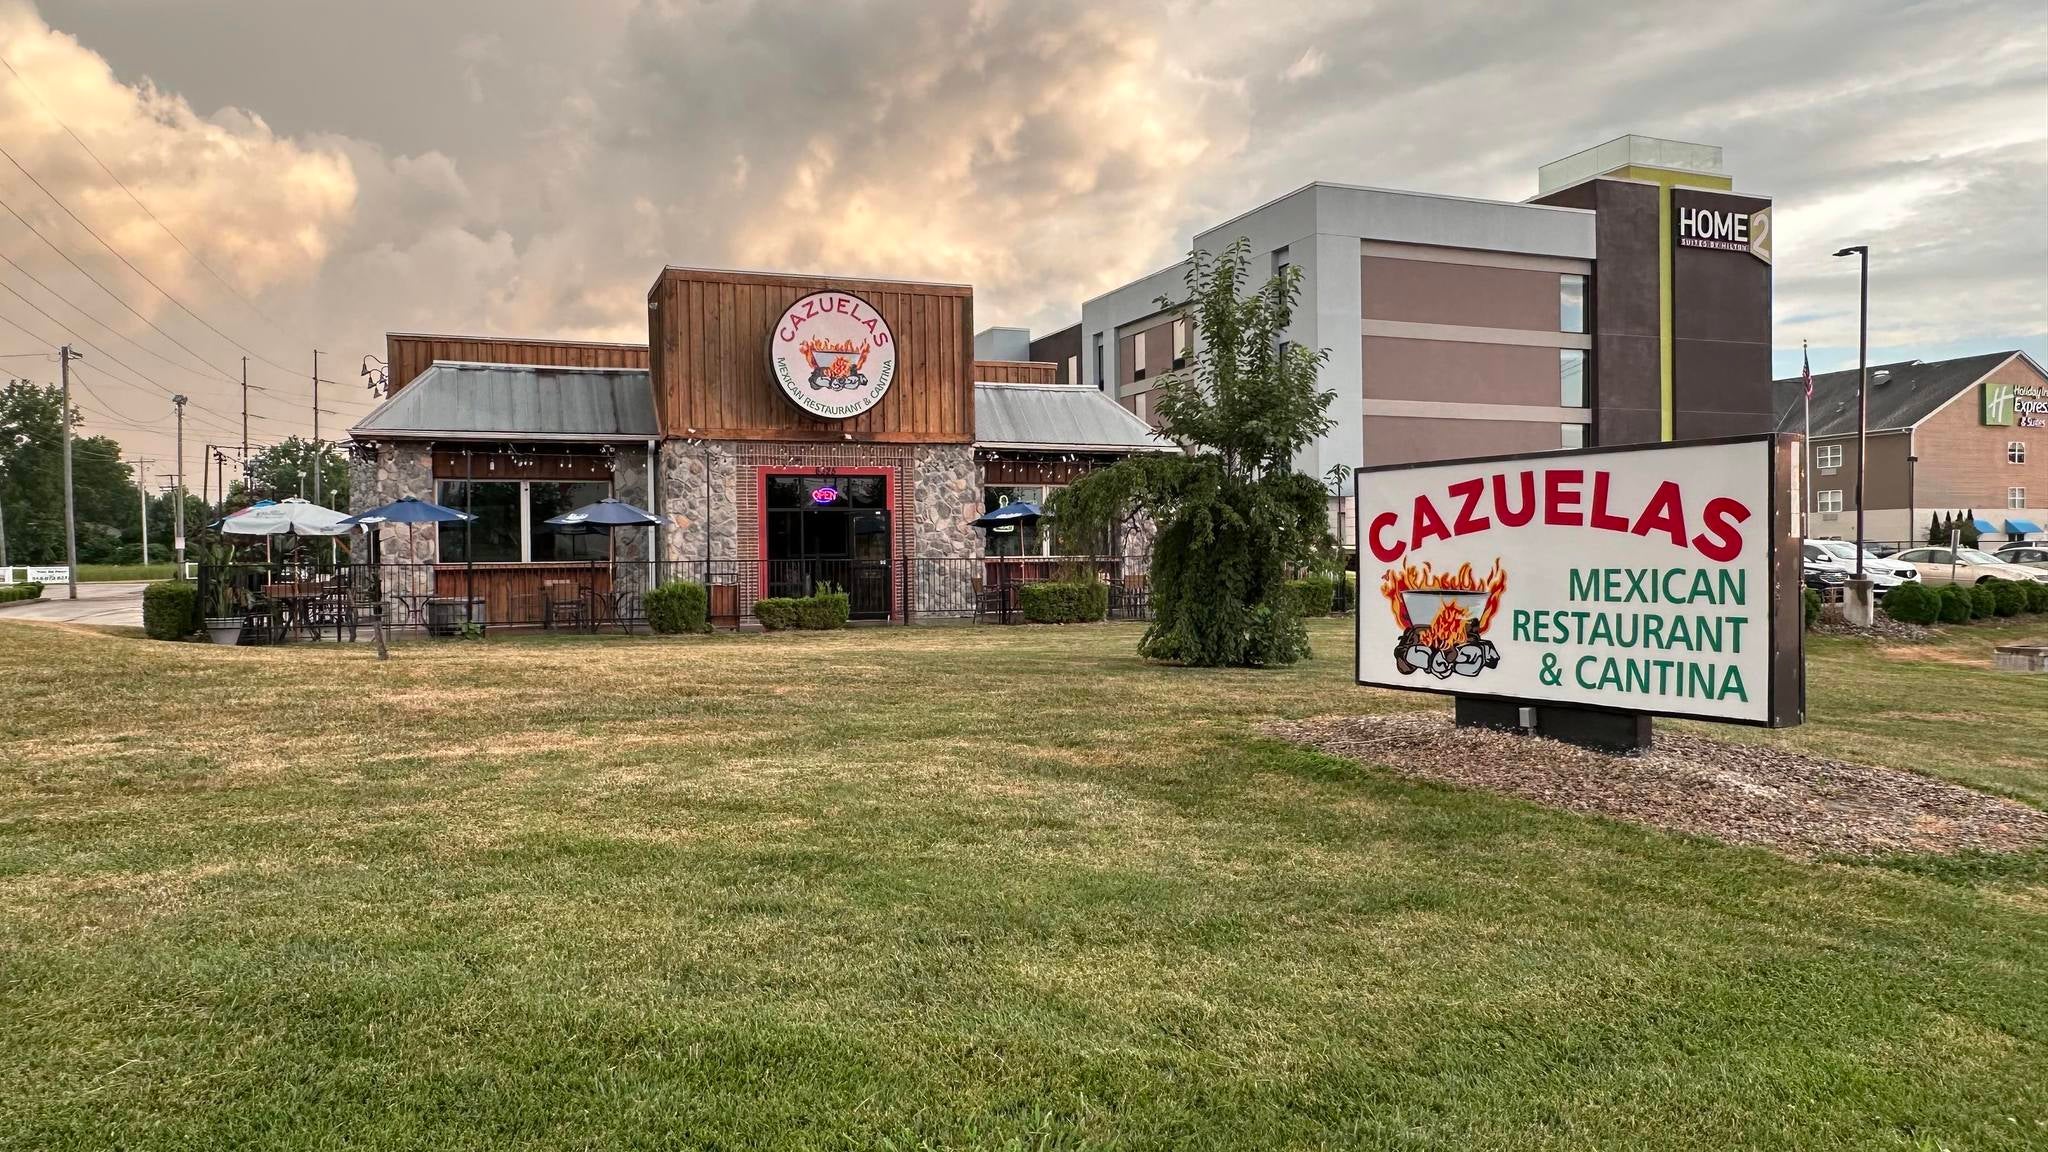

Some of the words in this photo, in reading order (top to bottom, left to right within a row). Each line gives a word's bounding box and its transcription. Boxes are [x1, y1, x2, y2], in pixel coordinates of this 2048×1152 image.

[1680, 206, 1748, 242] HOME
[1752, 213, 1770, 257] 2
[1681, 238, 1707, 248] SUITES
[1709, 240, 1719, 249] BY
[1721, 242, 1748, 251] HILTON
[780, 297, 889, 347] CAZUELAS
[777, 357, 805, 400] MEXICAN
[803, 397, 862, 415] RESTAURANT
[864, 397, 872, 406] &
[870, 359, 892, 399] CANTINA
[2014, 384, 2041, 399] Holiday
[2014, 396, 2048, 417] Expres
[812, 489, 837, 501] OPEN
[1368, 469, 1752, 563] CAZUELAS
[1569, 567, 1746, 606] MEXICAN
[1512, 609, 1748, 654] RESTAURANT
[1538, 653, 1562, 687] &
[1575, 655, 1749, 703] CANTINA
